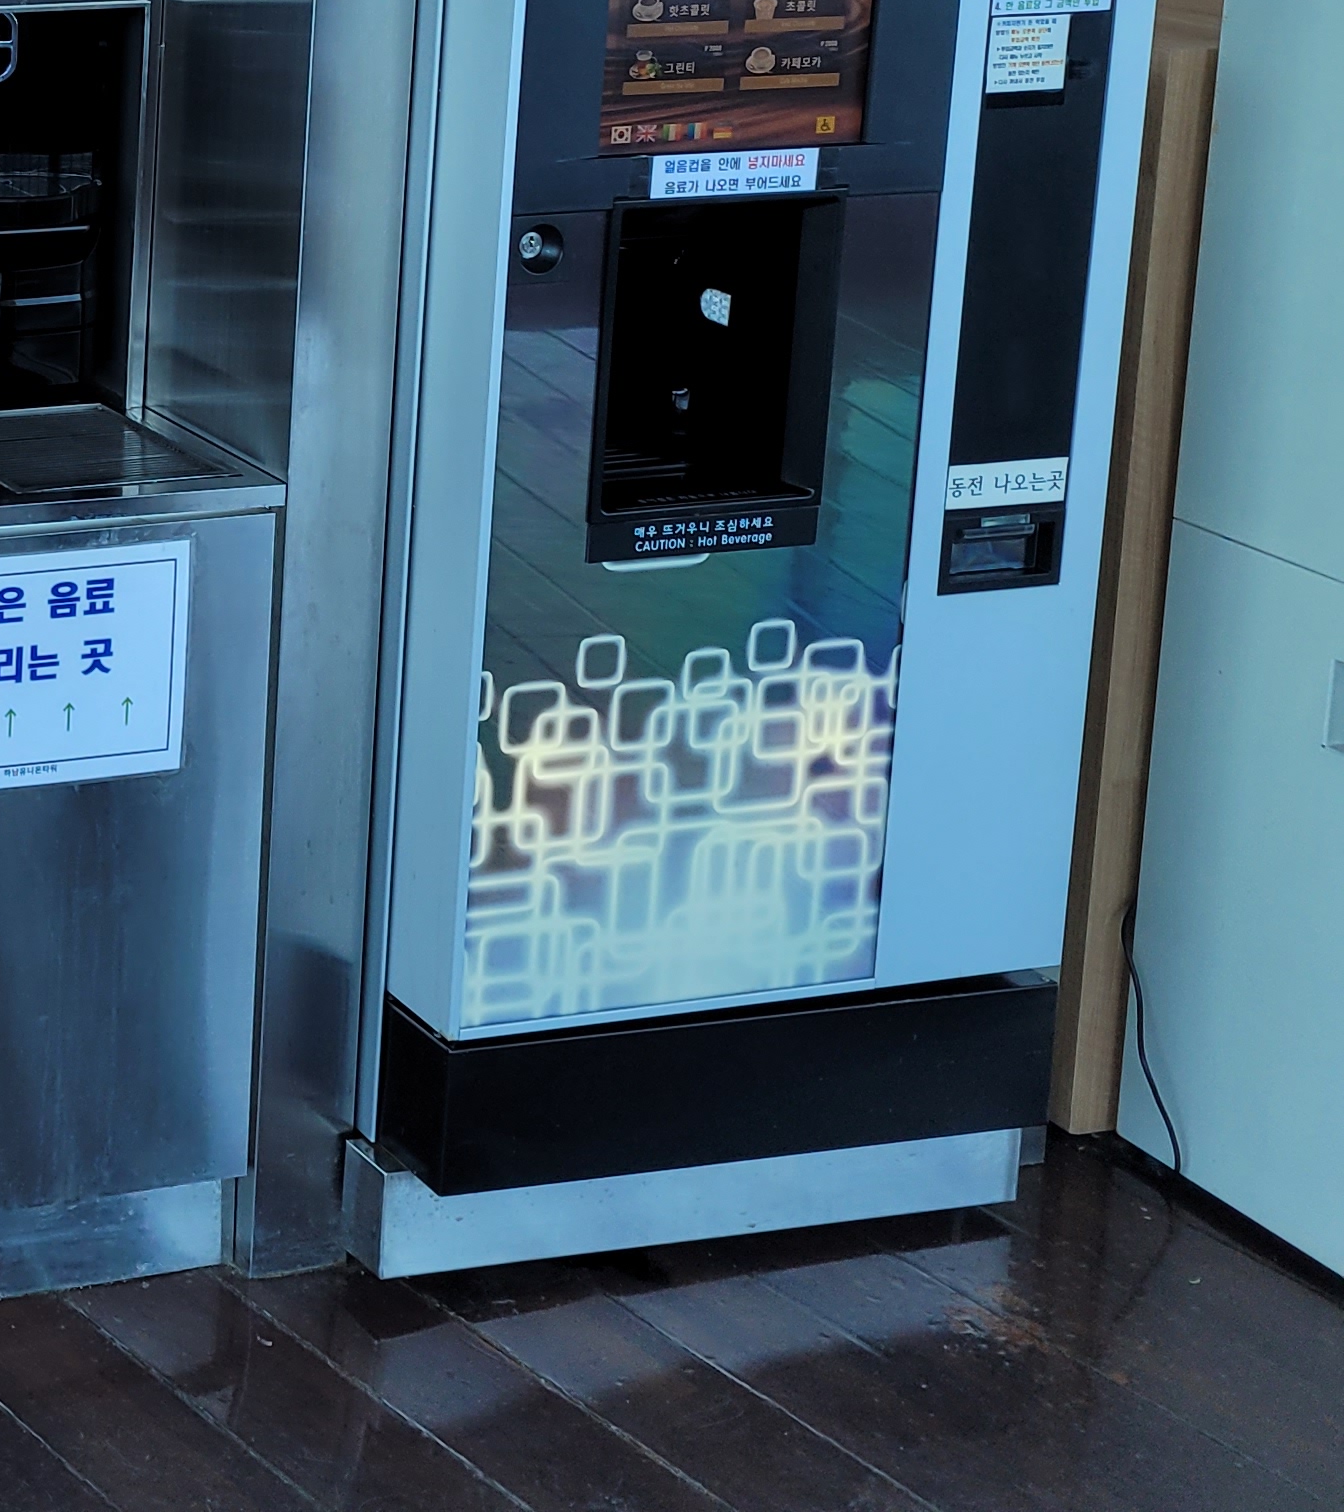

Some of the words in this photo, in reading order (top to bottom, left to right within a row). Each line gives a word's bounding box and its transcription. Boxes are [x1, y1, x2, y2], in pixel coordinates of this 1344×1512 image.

[665, 158, 712, 174] 얼음컵을
[719, 157, 741, 171] 안에
[665, 179, 699, 194] 음료가
[706, 178, 739, 192] 나오면
[746, 175, 802, 190] 부어드세요
[949, 476, 984, 498] 동전
[994, 470, 1064, 494] 나오는곳
[634, 525, 657, 538] 매우
[662, 521, 709, 536] 뜨거우니
[714, 516, 774, 532] 조심하세요
[635, 539, 686, 552] CAUTION
[698, 536, 717, 547] Hot
[721, 532, 772, 546] Beverage
[47, 577, 115, 620] 음료
[81, 638, 114, 676] 곳
[3, 764, 58, 777] 하남유니온타워
